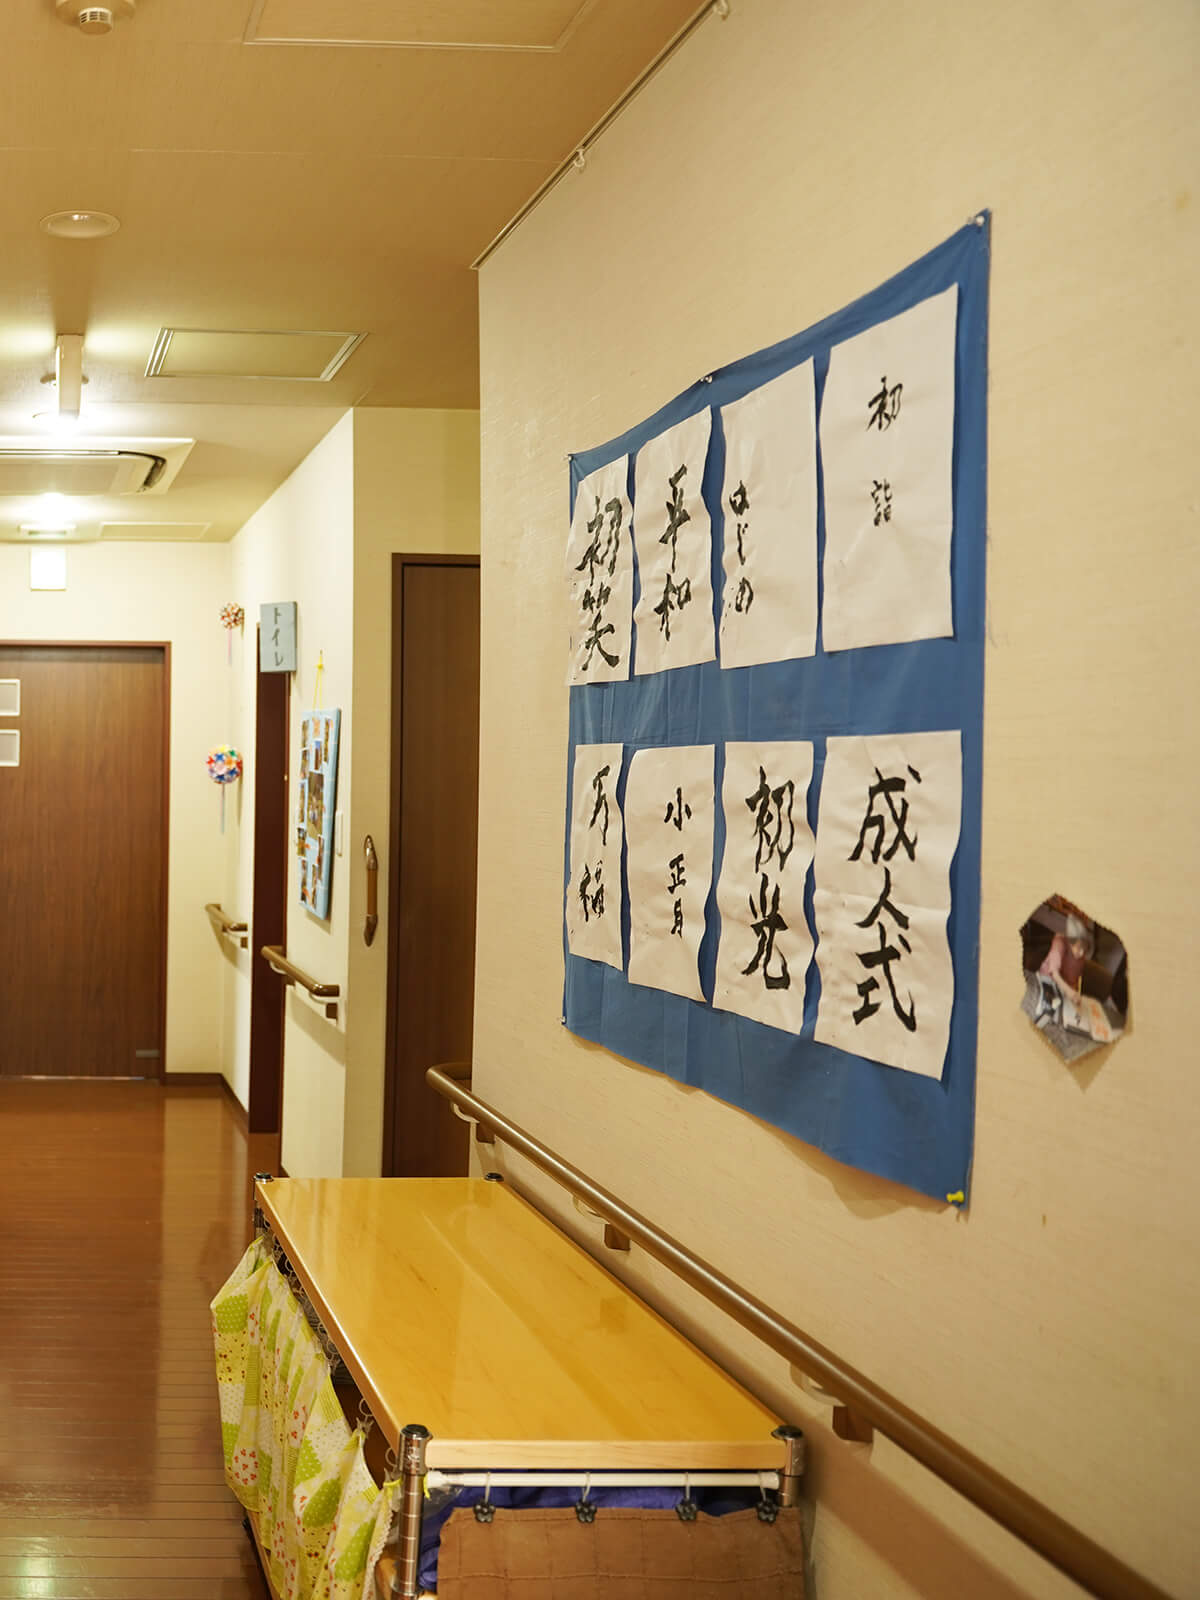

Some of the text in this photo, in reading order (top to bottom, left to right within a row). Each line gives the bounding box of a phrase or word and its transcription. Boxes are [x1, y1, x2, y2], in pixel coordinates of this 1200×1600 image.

[866, 375, 903, 527] 初詣
[272, 606, 284, 667] トイレ
[574, 495, 623, 672] 初笑
[653, 463, 692, 642] 平和
[663, 787, 693, 939] 小正月
[741, 766, 796, 990] 初光
[847, 765, 923, 1033] 成人式
